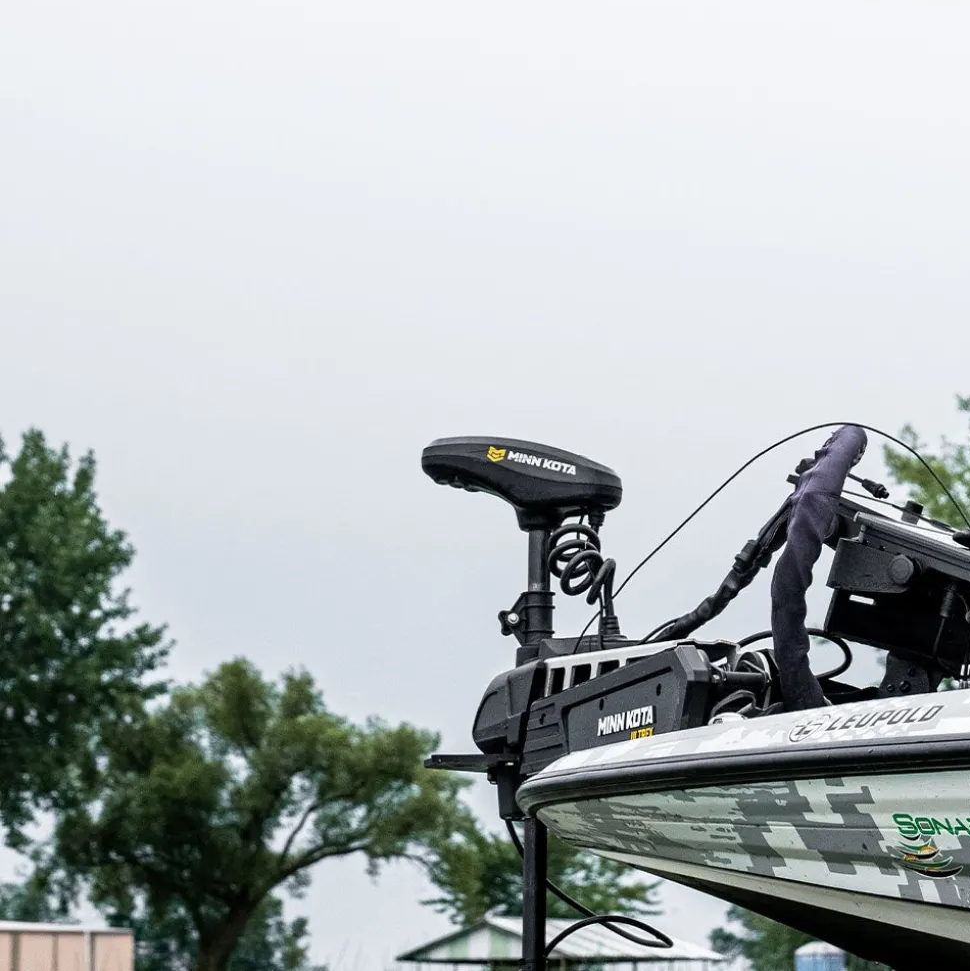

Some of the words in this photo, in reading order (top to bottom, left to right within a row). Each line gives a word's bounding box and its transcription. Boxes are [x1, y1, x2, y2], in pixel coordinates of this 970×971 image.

[507, 450, 542, 467] MINN
[542, 458, 577, 475] KOTA
[597, 712, 625, 737] MINN
[625, 705, 654, 730] KOTA
[824, 704, 945, 732] LEUPOLD
